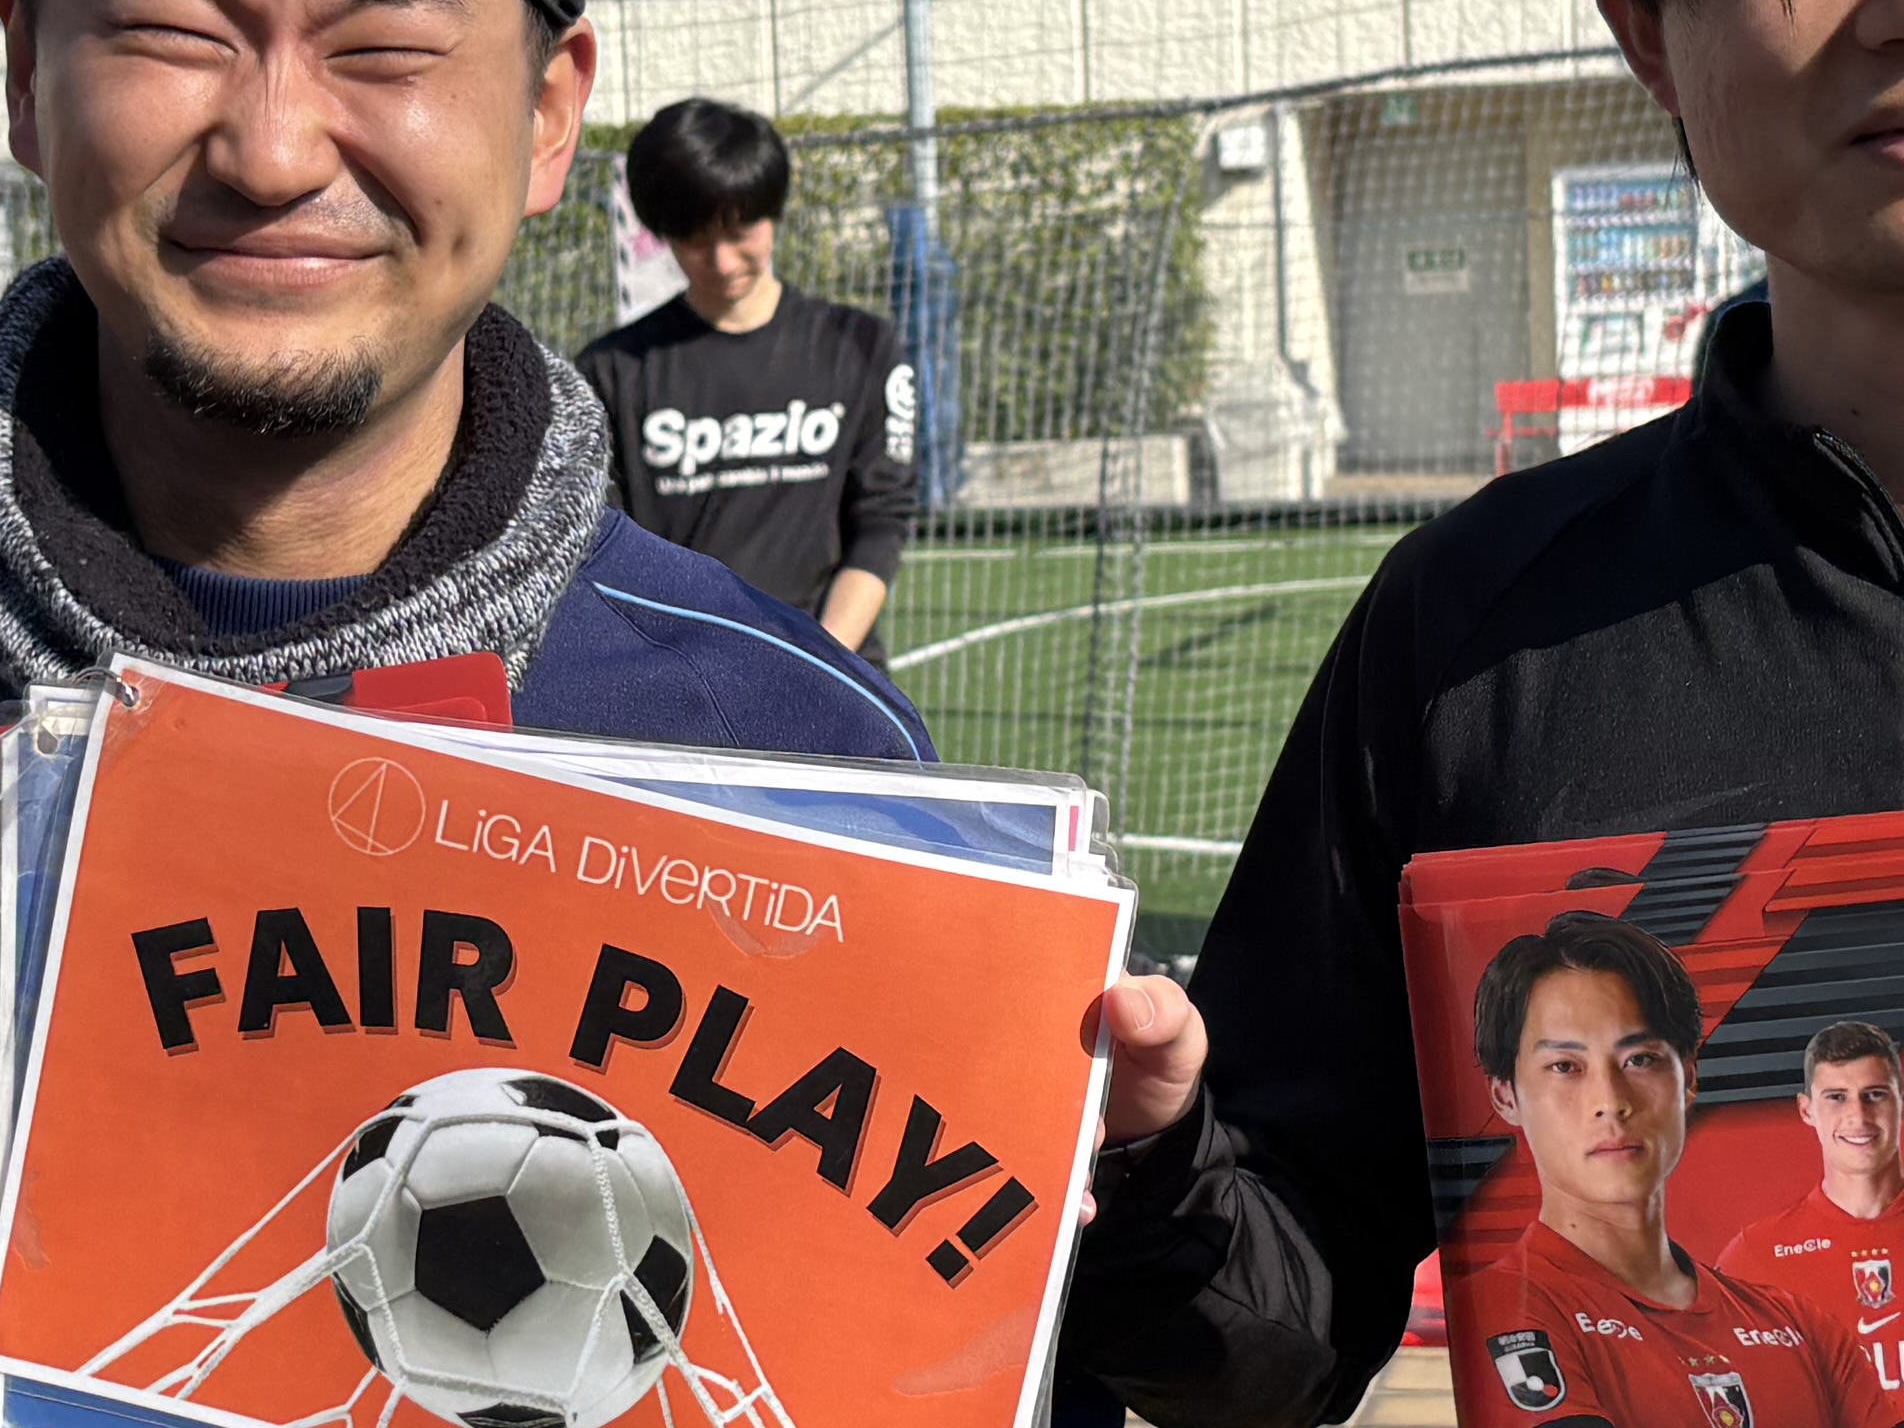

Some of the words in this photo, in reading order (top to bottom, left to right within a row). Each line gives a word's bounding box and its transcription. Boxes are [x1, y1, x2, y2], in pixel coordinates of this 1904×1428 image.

[642, 399, 840, 476] Spazio
[131, 905, 520, 1057] FAIR
[568, 942, 1040, 1290] PLAY!
